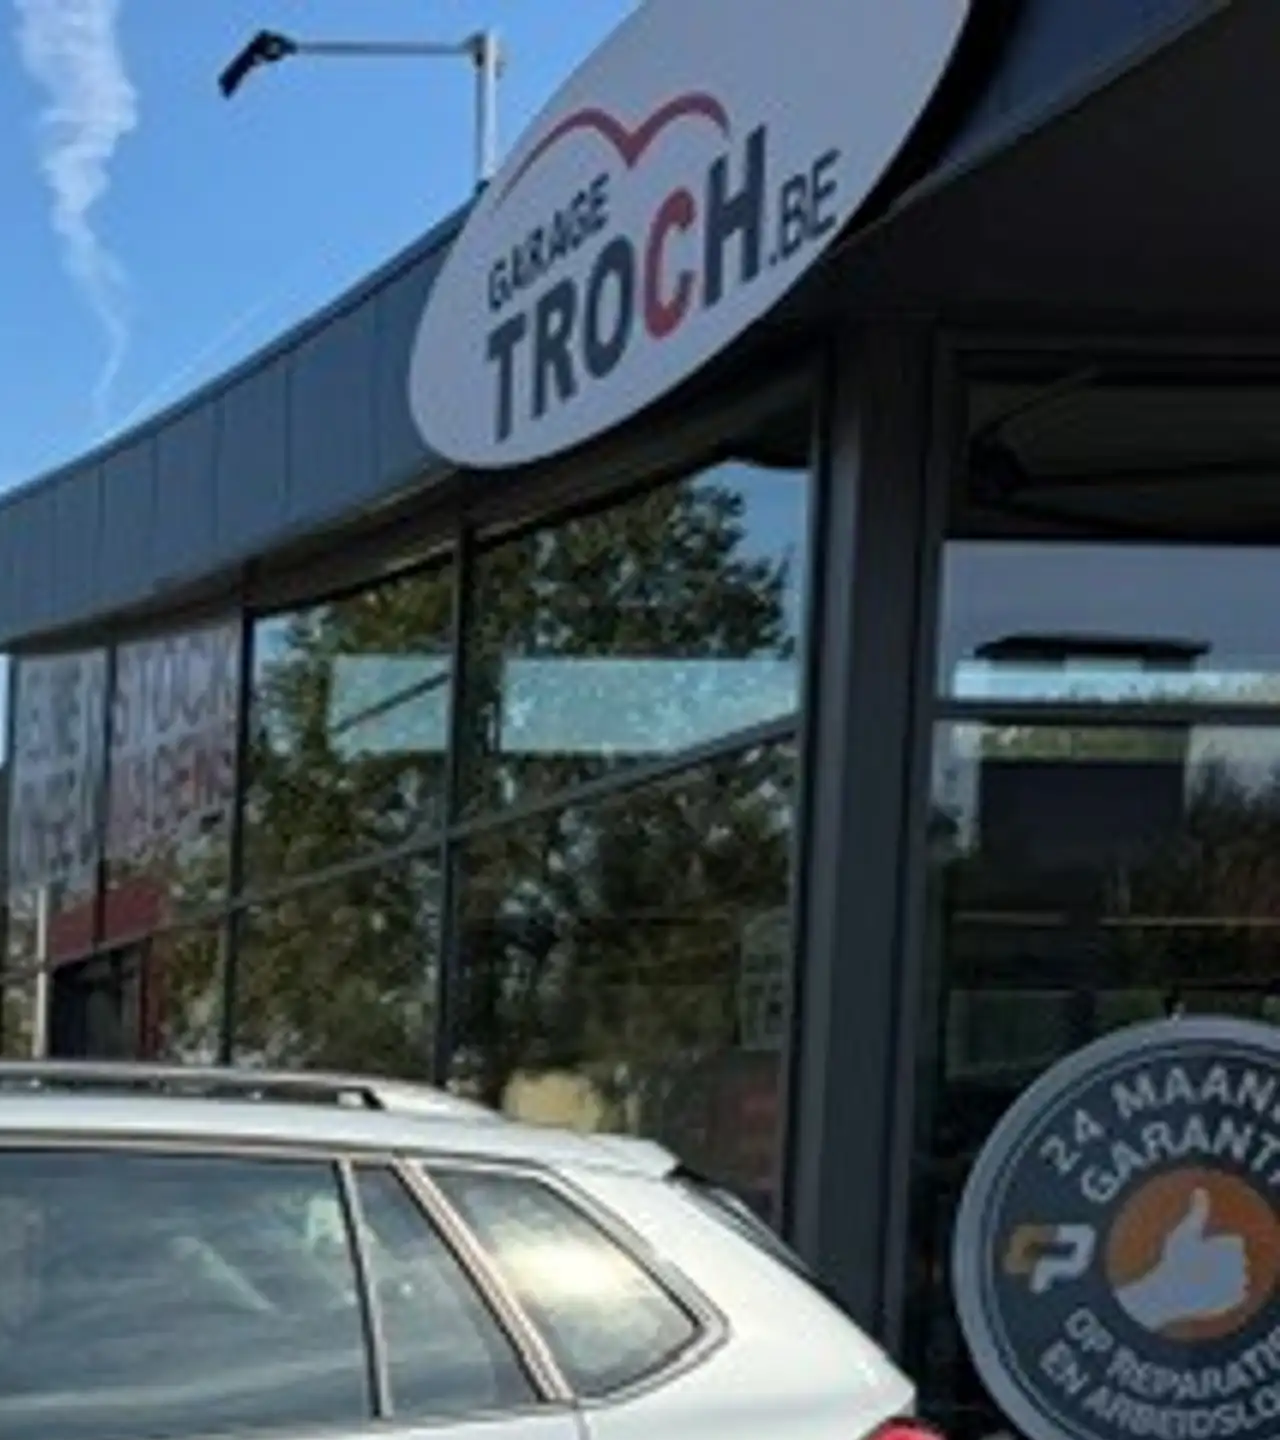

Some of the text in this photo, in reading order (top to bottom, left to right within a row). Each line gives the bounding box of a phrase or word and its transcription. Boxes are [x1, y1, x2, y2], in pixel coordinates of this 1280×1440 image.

[488, 172, 610, 313] GARAGE
[1042, 1062, 1280, 1174] 24 MAAN
[1079, 1113, 1280, 1204] GARANT
[1040, 1341, 1089, 1397] EN
